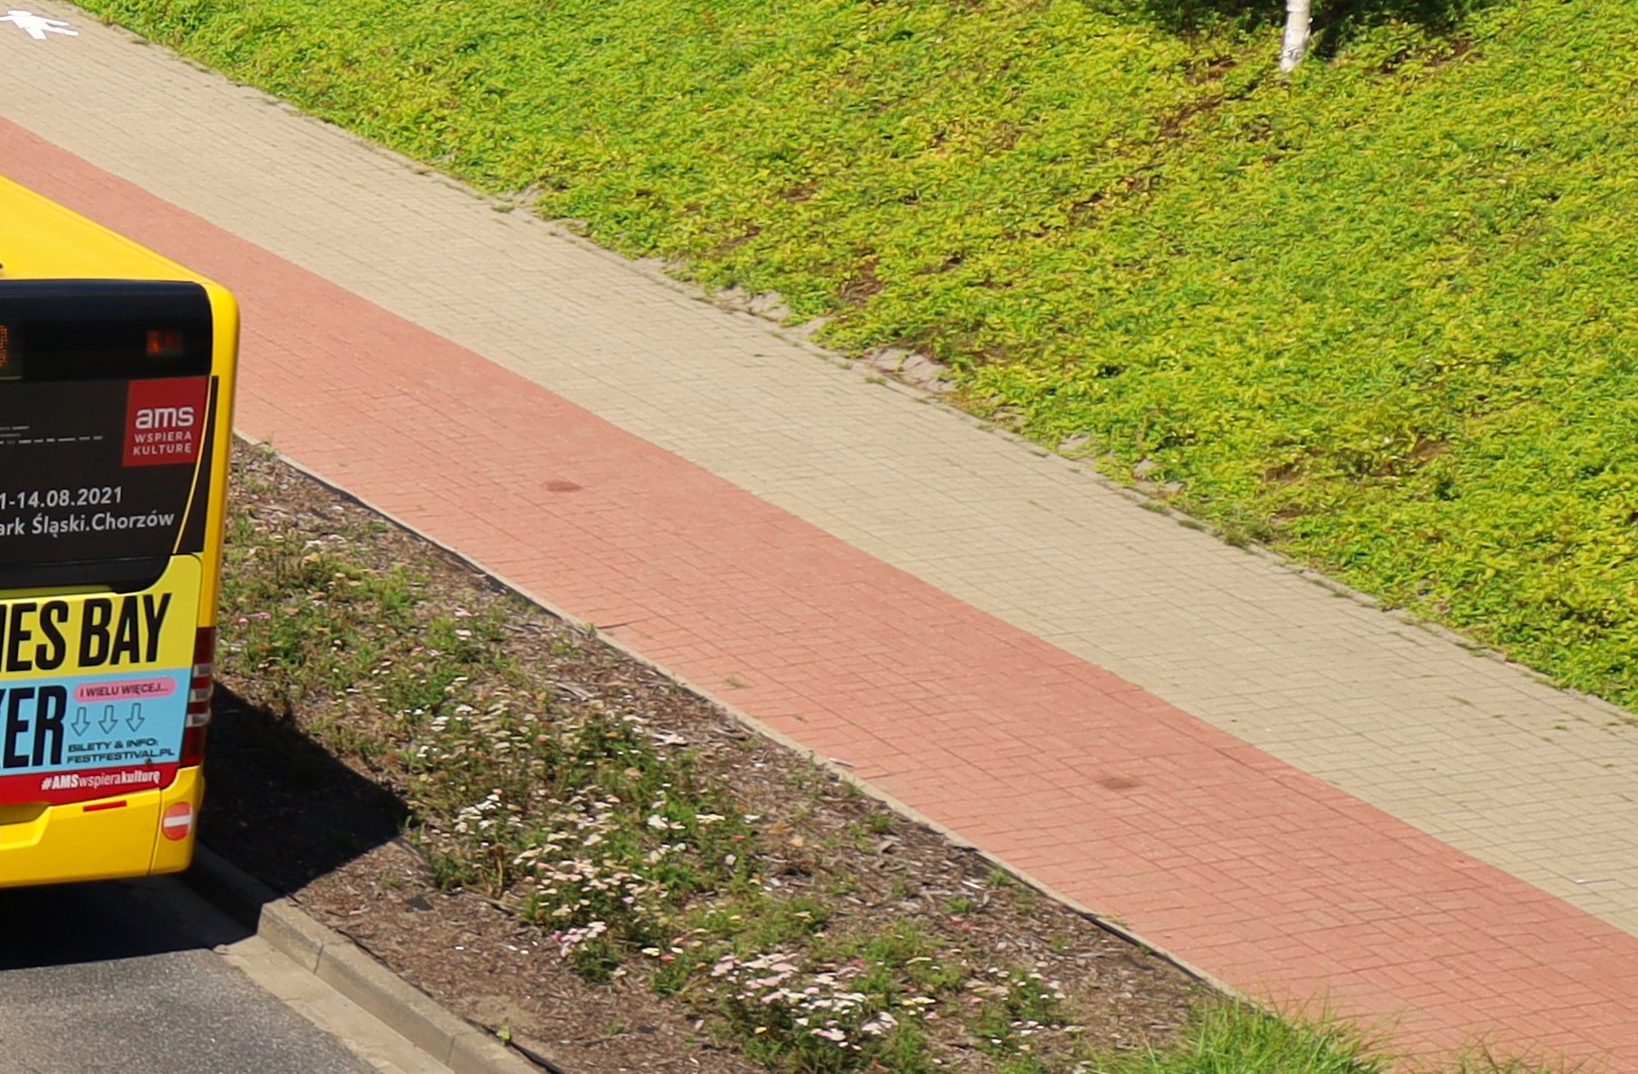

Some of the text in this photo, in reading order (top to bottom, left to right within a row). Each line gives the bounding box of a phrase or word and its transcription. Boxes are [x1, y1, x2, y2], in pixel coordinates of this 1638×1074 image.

[135, 406, 194, 429] ams
[134, 431, 192, 443] WSPIERA
[77, 592, 174, 668] BAY
[85, 686, 120, 697] WIELU
[68, 738, 159, 753] BILETY & INFO:
[66, 748, 175, 764] FESTFESTIVAL.PL
[41, 770, 162, 791] #AMSwspierakulturę
